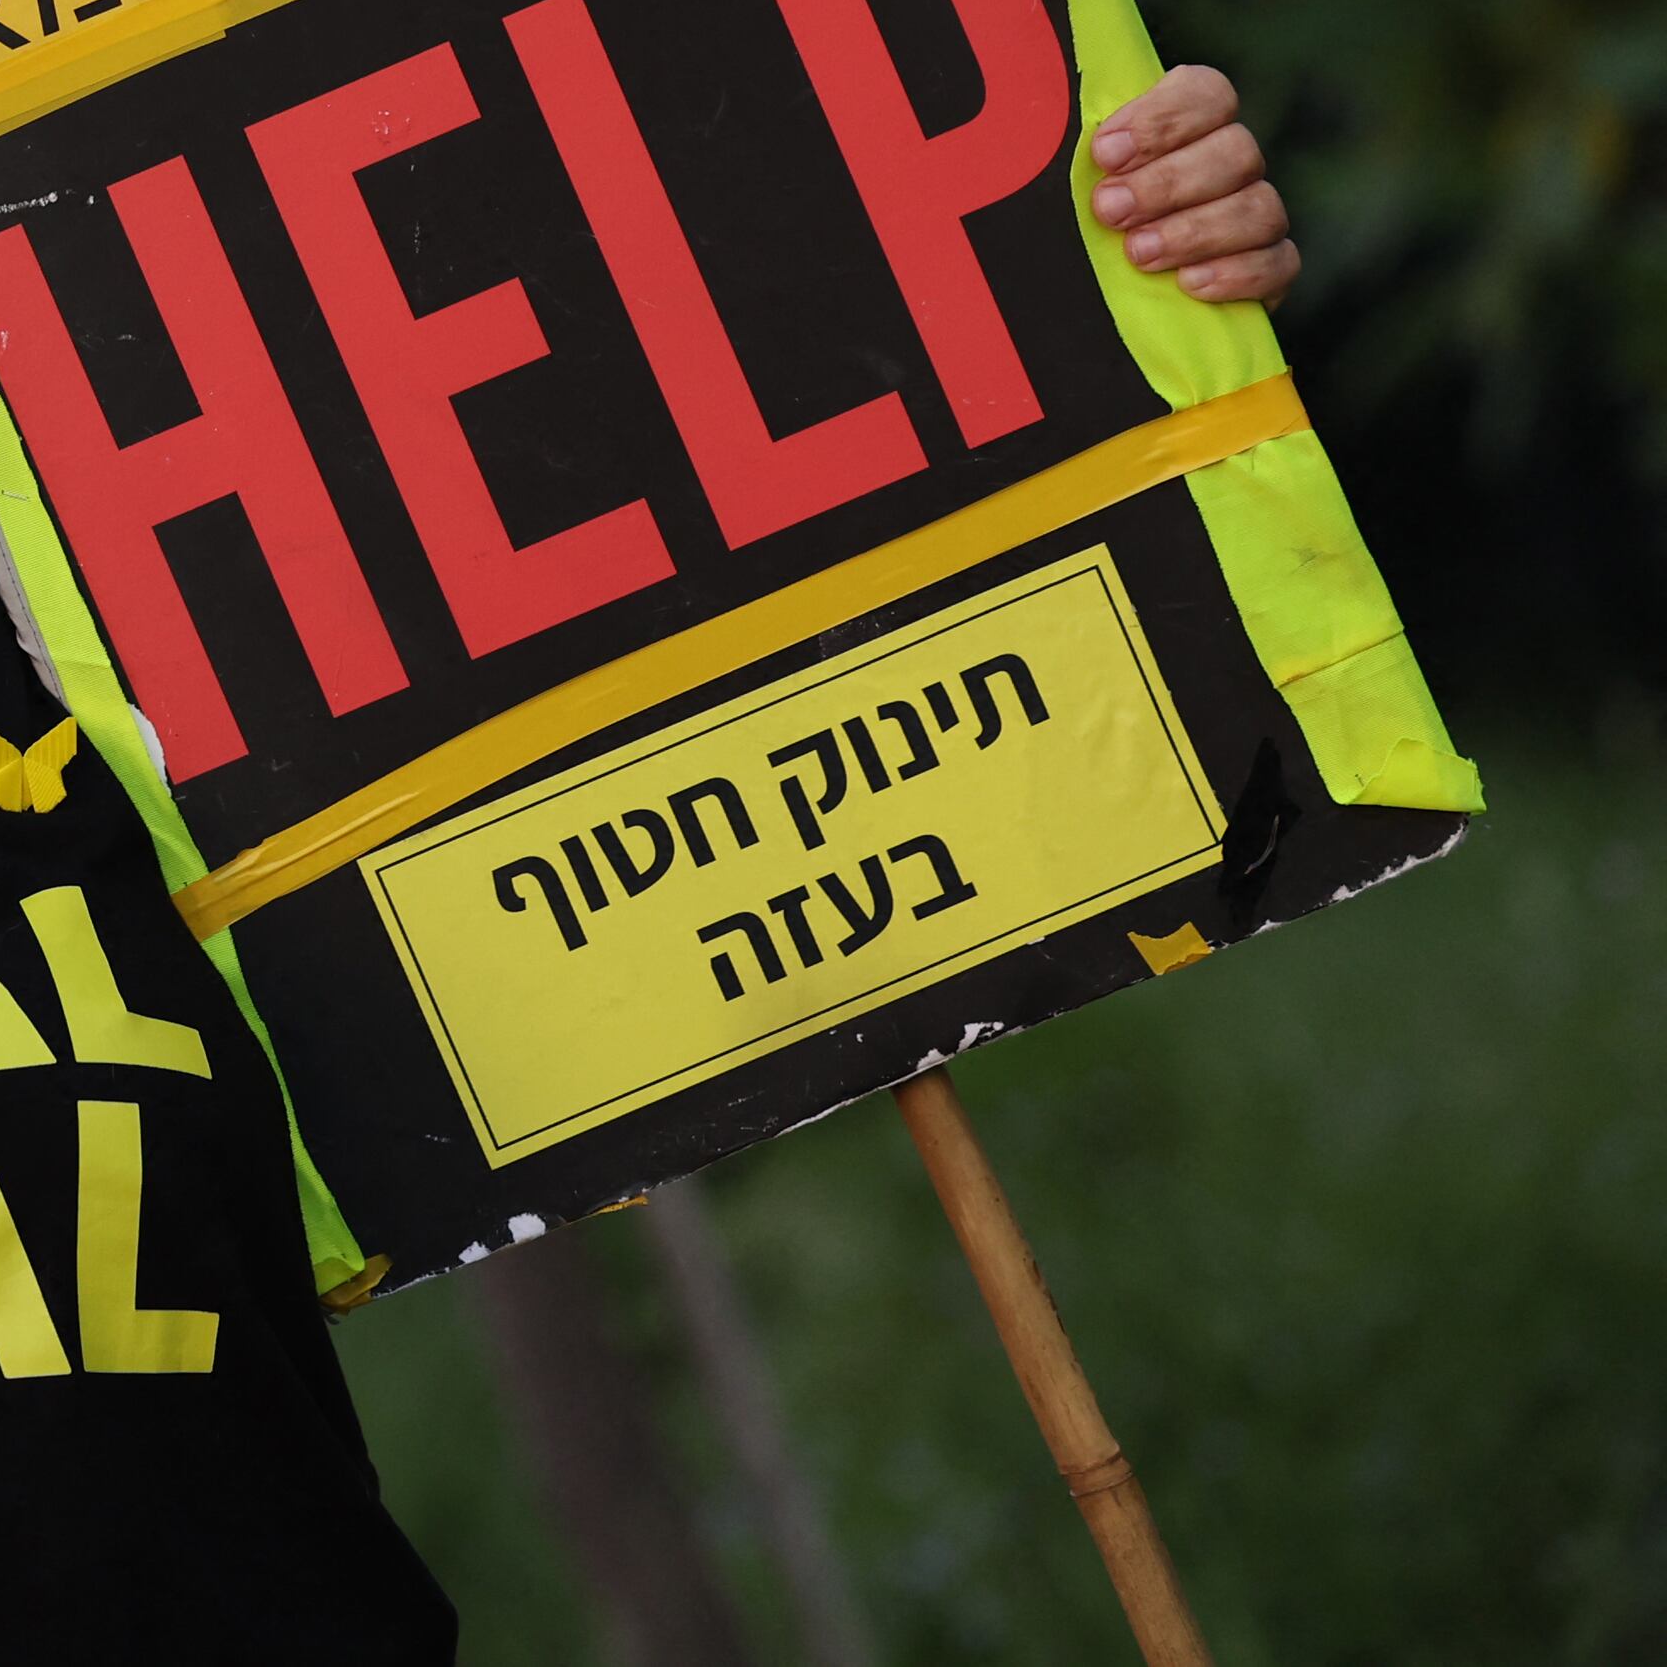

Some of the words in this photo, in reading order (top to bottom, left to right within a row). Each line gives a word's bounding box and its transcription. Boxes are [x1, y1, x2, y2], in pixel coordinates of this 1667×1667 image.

[766, 652, 1051, 852] תינוק
[491, 775, 761, 952] חטוף
[695, 833, 979, 1003] בעזה
